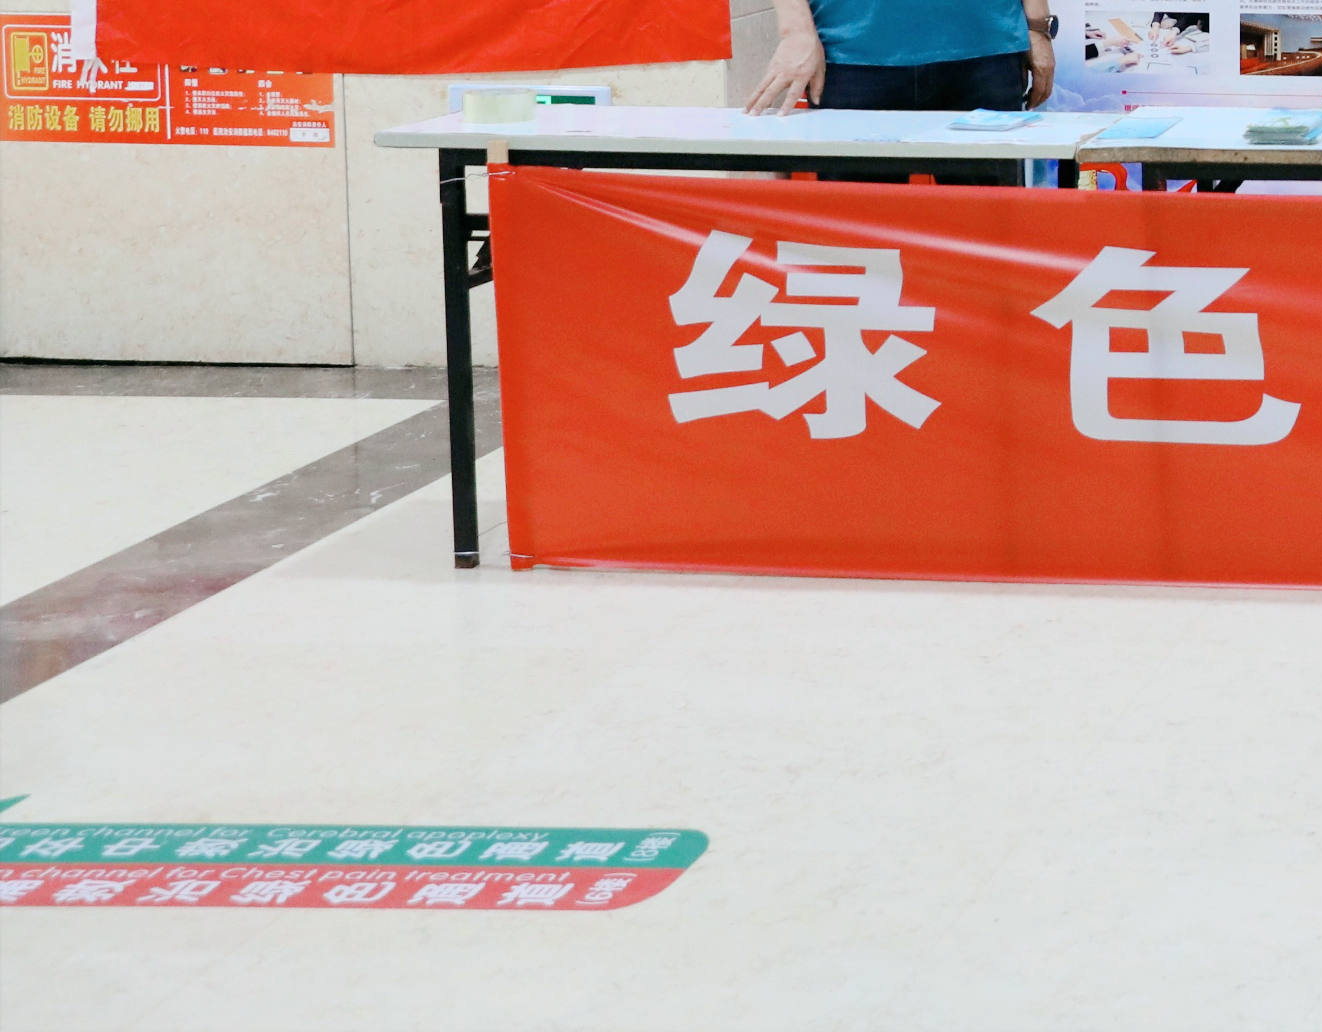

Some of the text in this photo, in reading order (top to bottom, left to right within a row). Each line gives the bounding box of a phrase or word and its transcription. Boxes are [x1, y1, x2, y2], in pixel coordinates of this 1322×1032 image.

[53, 80, 73, 89] FIRE
[8, 104, 160, 133] 消防设备 请勿挪用
[77, 826, 199, 838] channel
[208, 827, 251, 838] for
[267, 828, 403, 839] Cerebral
[406, 829, 549, 841] apoplexy
[0, 836, 625, 861] 卒中救治绿色通道
[21, 866, 572, 882] channel for Chest pain treatment
